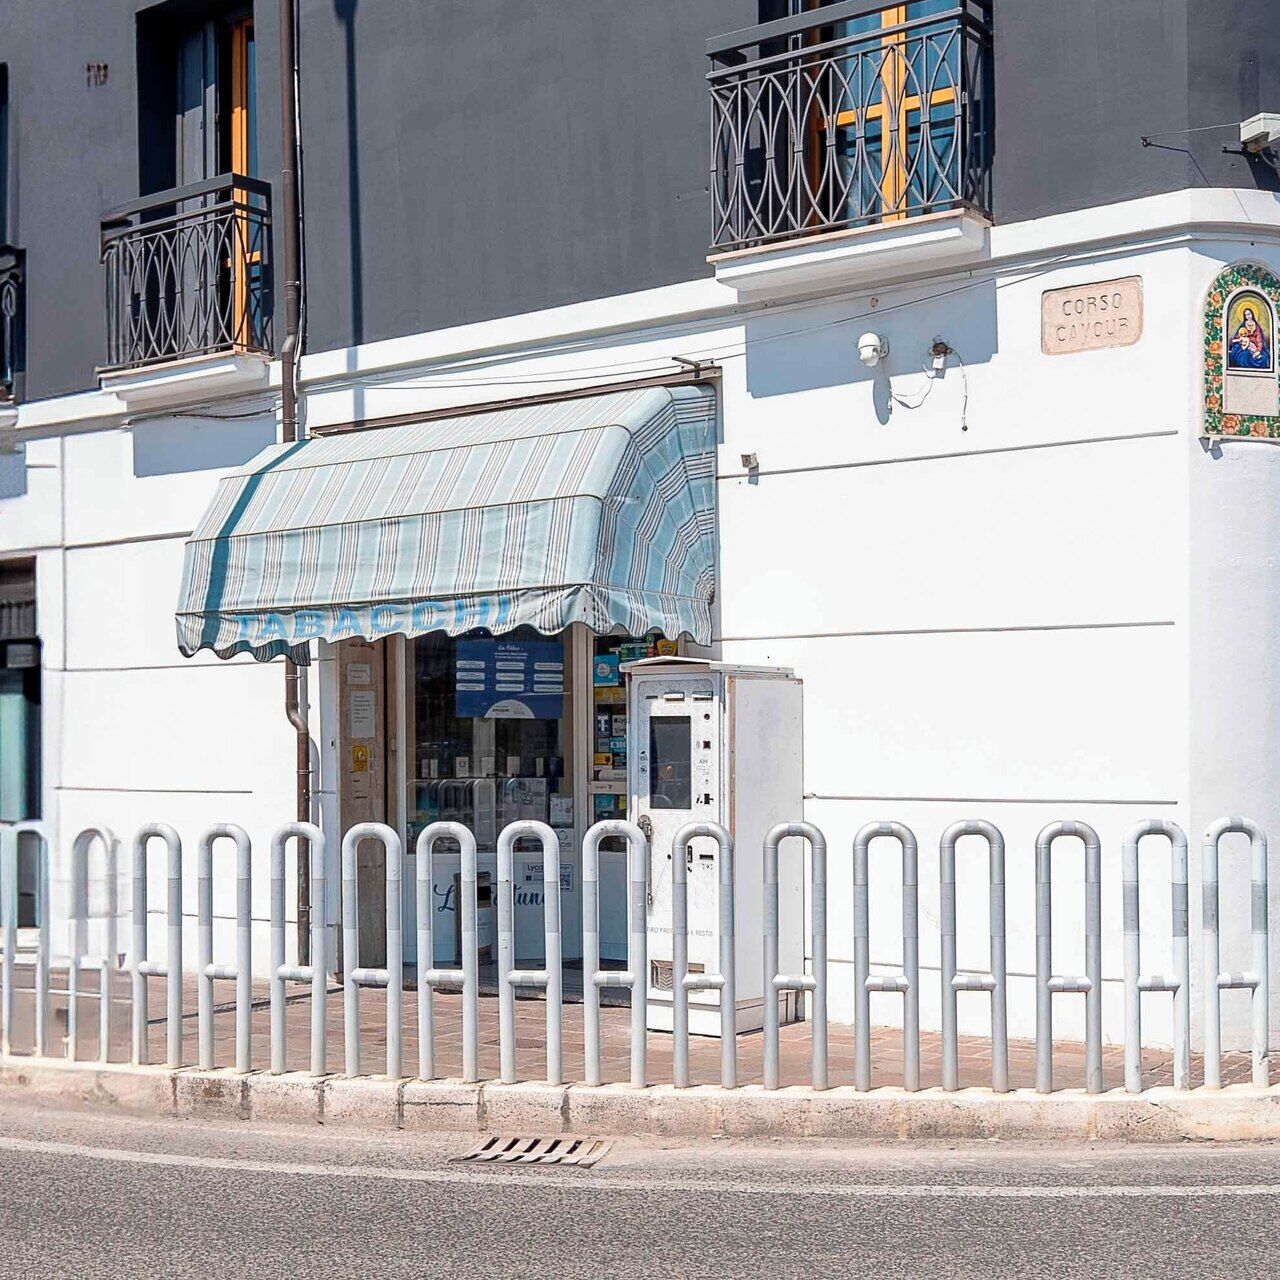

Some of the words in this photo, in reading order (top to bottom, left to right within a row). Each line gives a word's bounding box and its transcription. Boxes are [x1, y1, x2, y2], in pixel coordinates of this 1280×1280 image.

[1062, 293, 1122, 316] CORSO
[1056, 317, 1128, 342] CAVOUR
[234, 596, 510, 639] TABACCHI
